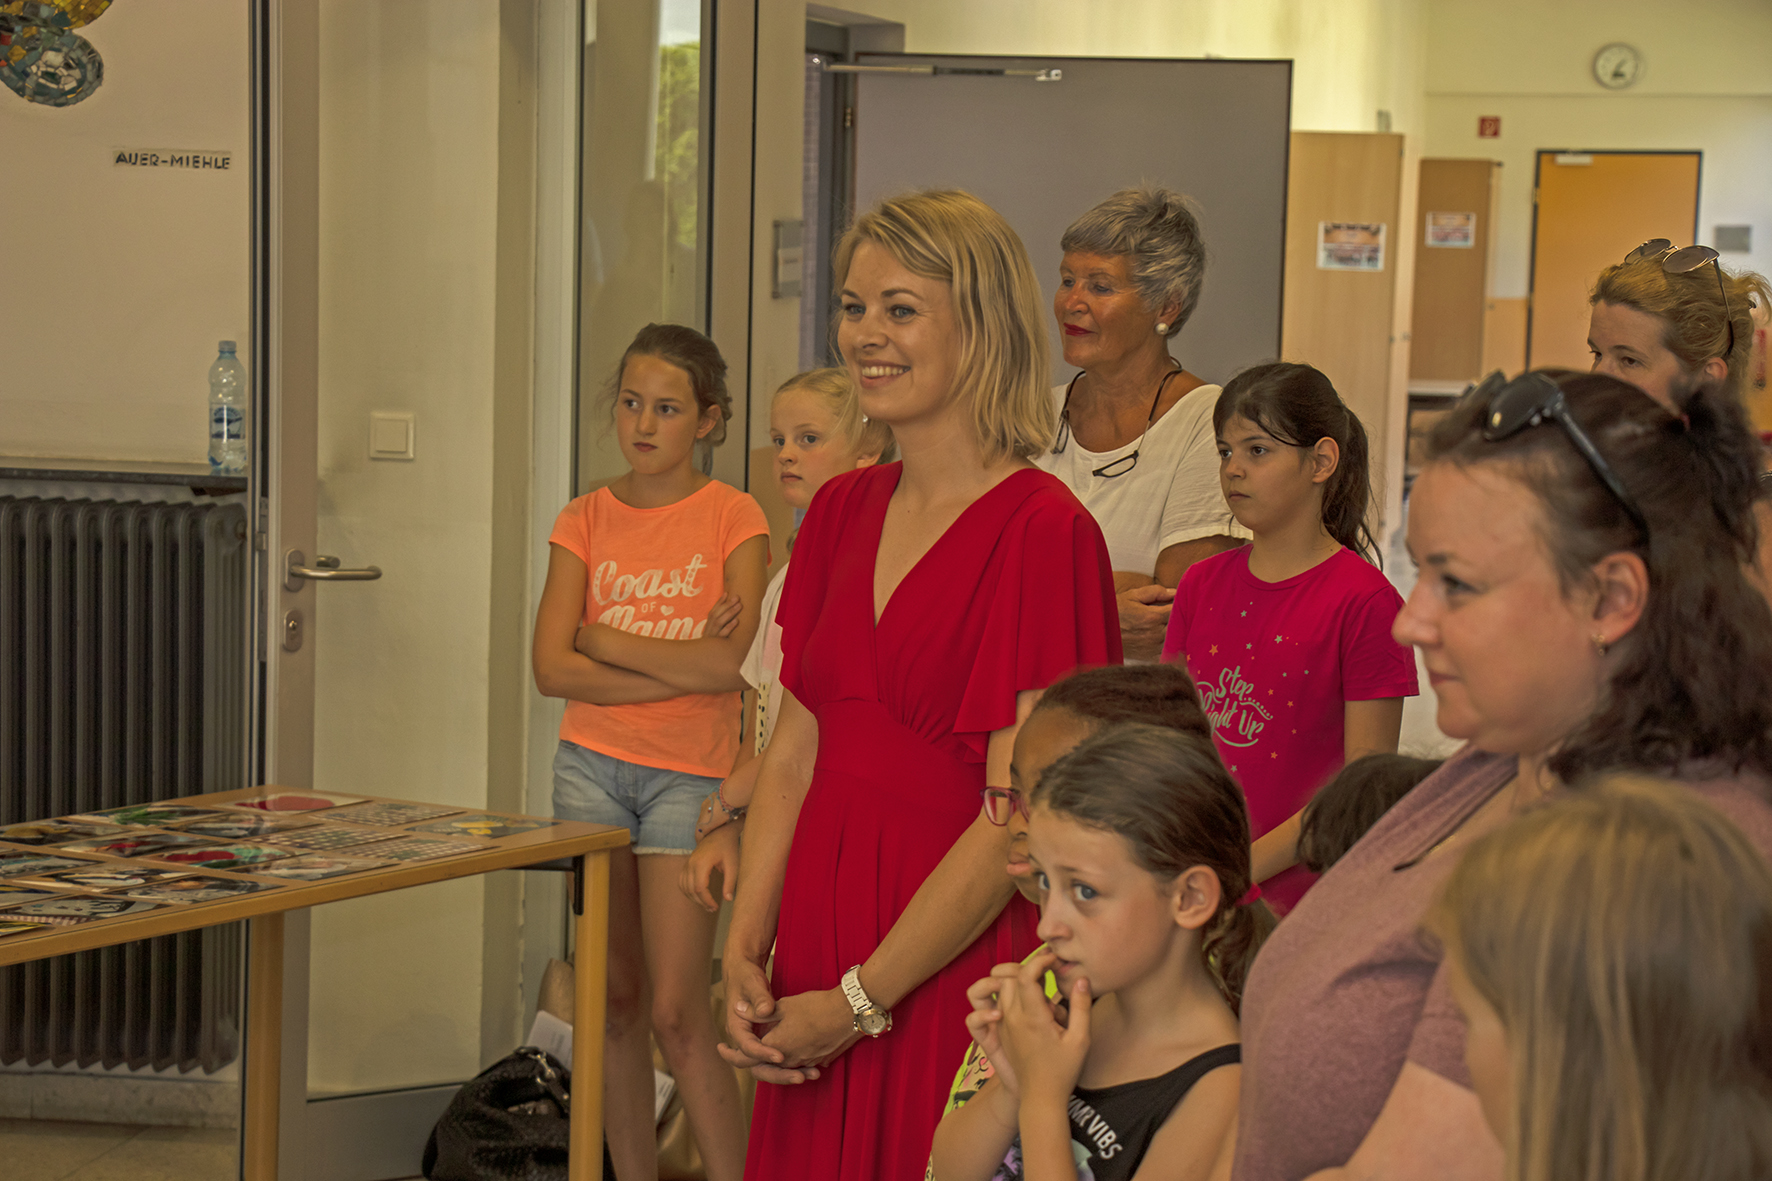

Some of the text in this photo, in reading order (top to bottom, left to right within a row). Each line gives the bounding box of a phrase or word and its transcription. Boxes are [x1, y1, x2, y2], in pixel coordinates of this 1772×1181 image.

[115, 152, 230, 170] AUER-MIEHLE
[592, 553, 708, 606] Coast
[641, 601, 658, 614] OF
[1215, 665, 1255, 701] Step
[1238, 709, 1265, 740] Up
